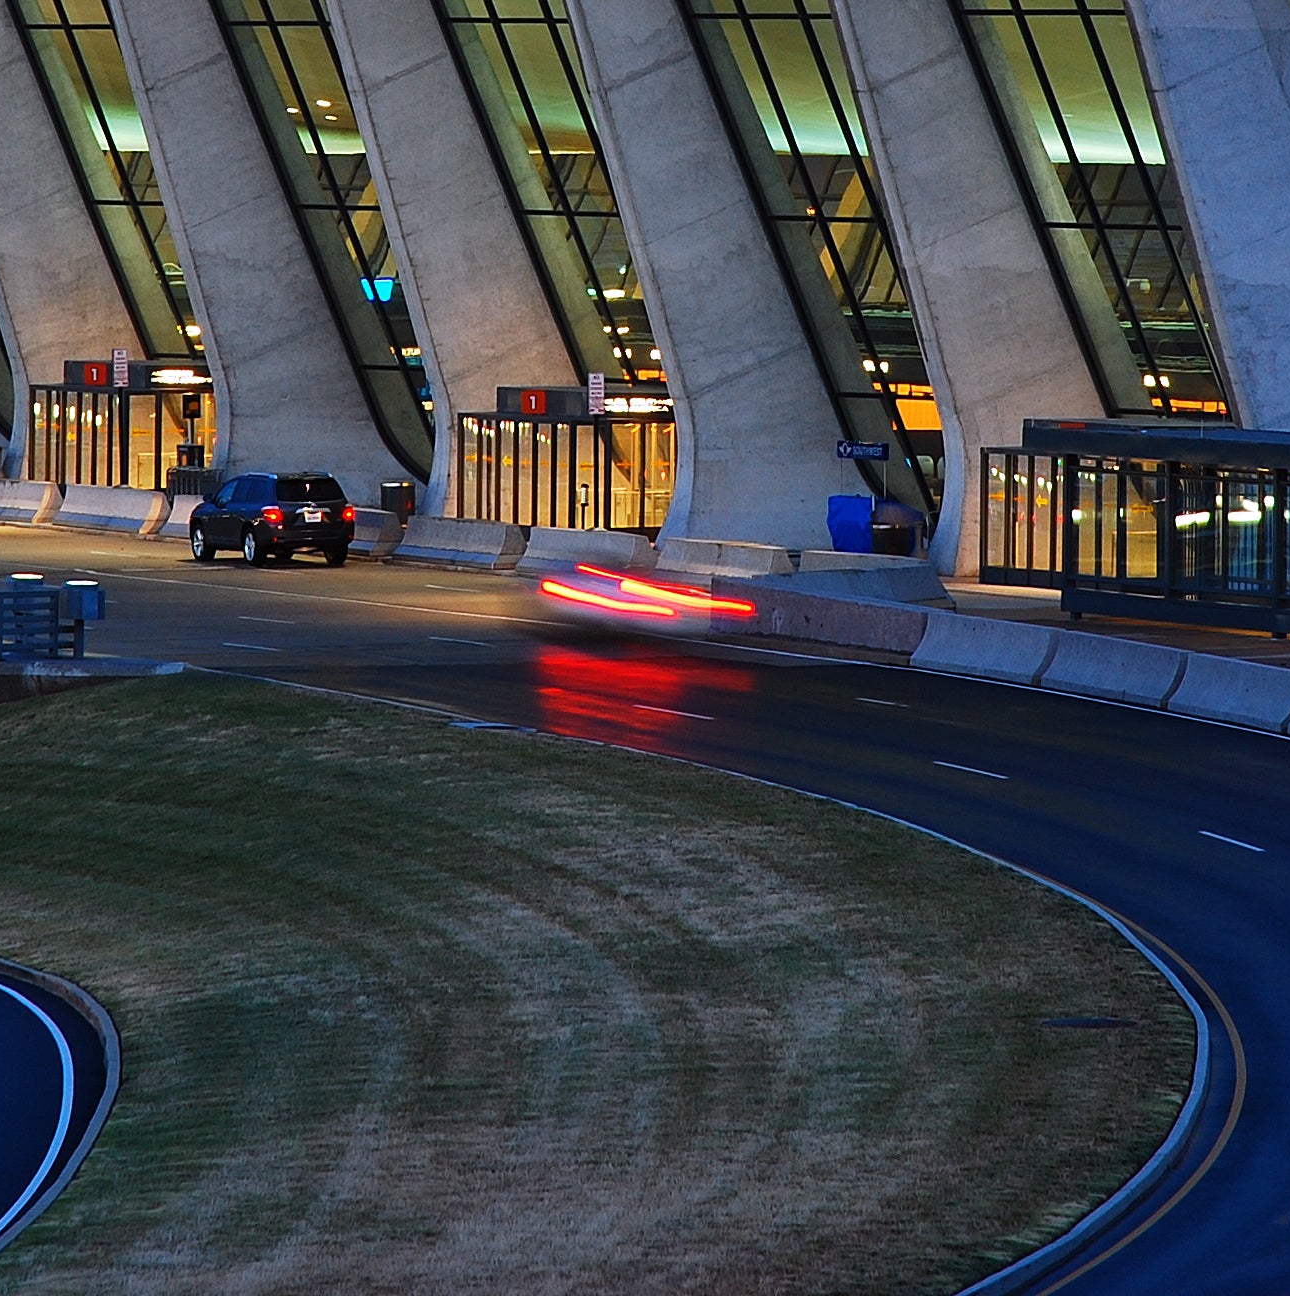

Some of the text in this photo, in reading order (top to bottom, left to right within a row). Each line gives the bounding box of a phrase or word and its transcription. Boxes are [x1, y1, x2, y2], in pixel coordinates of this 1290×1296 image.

[90, 368, 98, 381] 1
[529, 395, 536, 410] 1
[852, 445, 884, 456] SOUTHWEST
